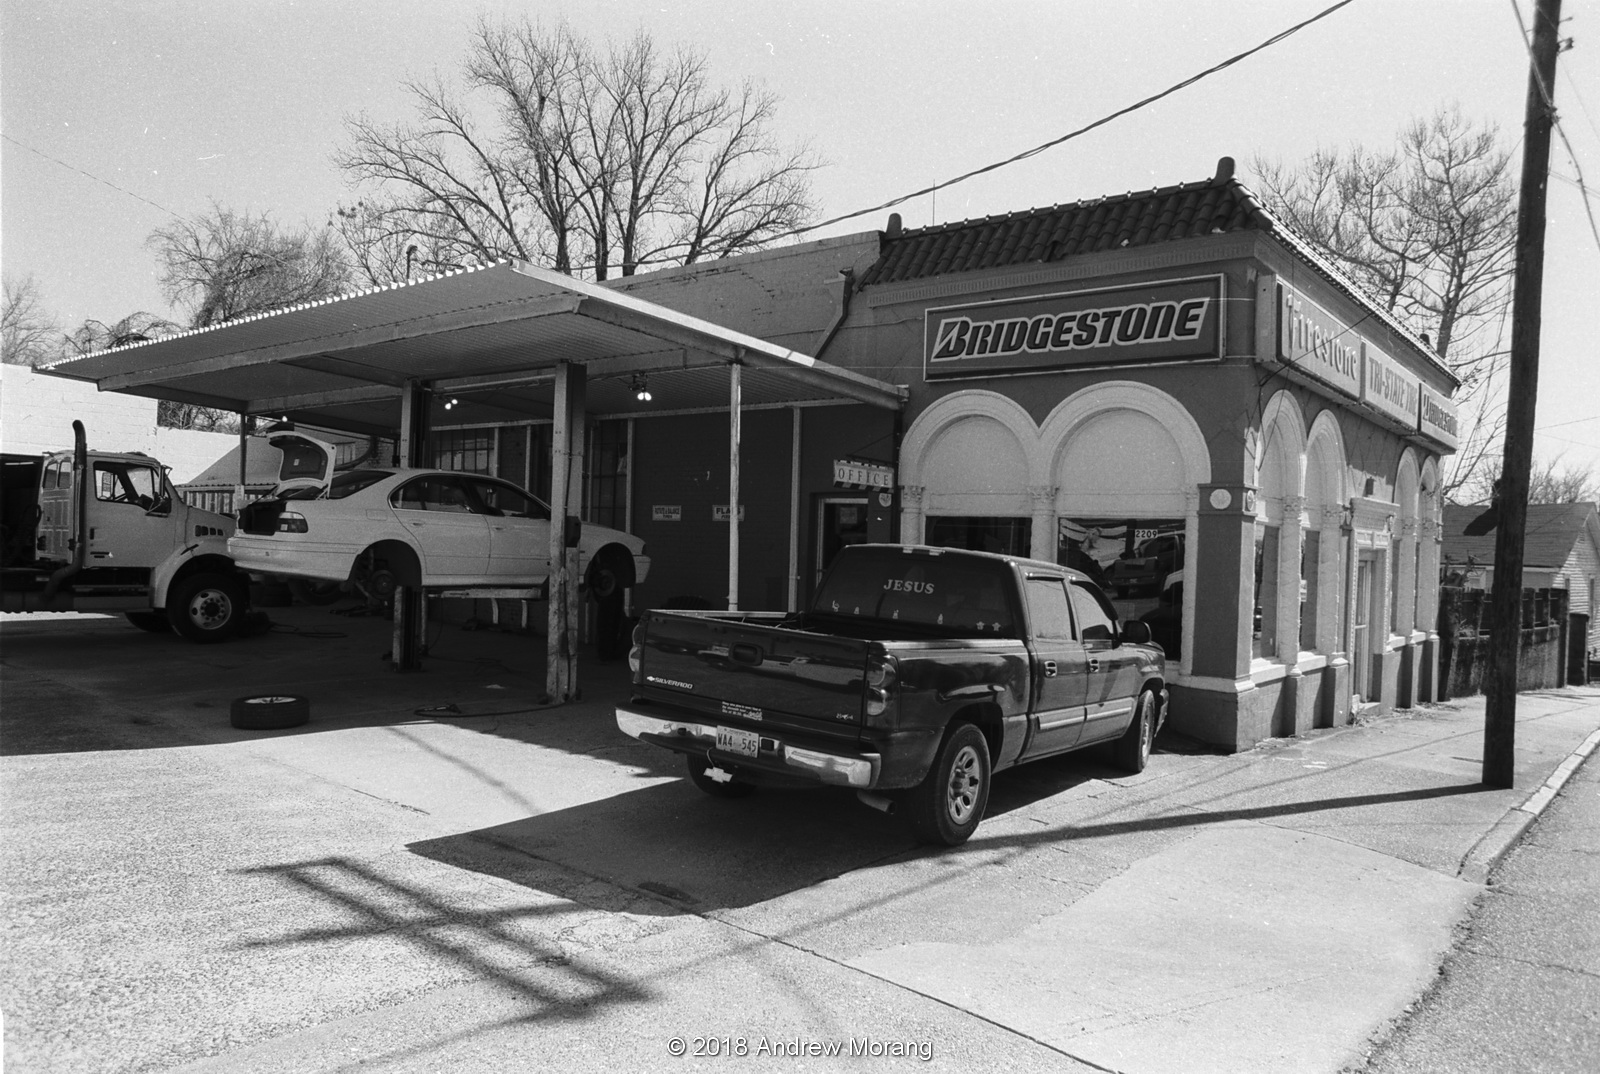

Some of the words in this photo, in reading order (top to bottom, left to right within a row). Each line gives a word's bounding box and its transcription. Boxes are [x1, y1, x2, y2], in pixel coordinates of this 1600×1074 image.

[931, 297, 1210, 361] BRIDGESTONE
[838, 467, 889, 486] OFFICE
[716, 507, 741, 515] FLAS
[1135, 530, 1157, 538] 2209
[883, 578, 935, 595] JESUS
[654, 677, 693, 689] SILVERADO
[717, 732, 733, 748] WA4
[741, 738, 757, 753] 545
